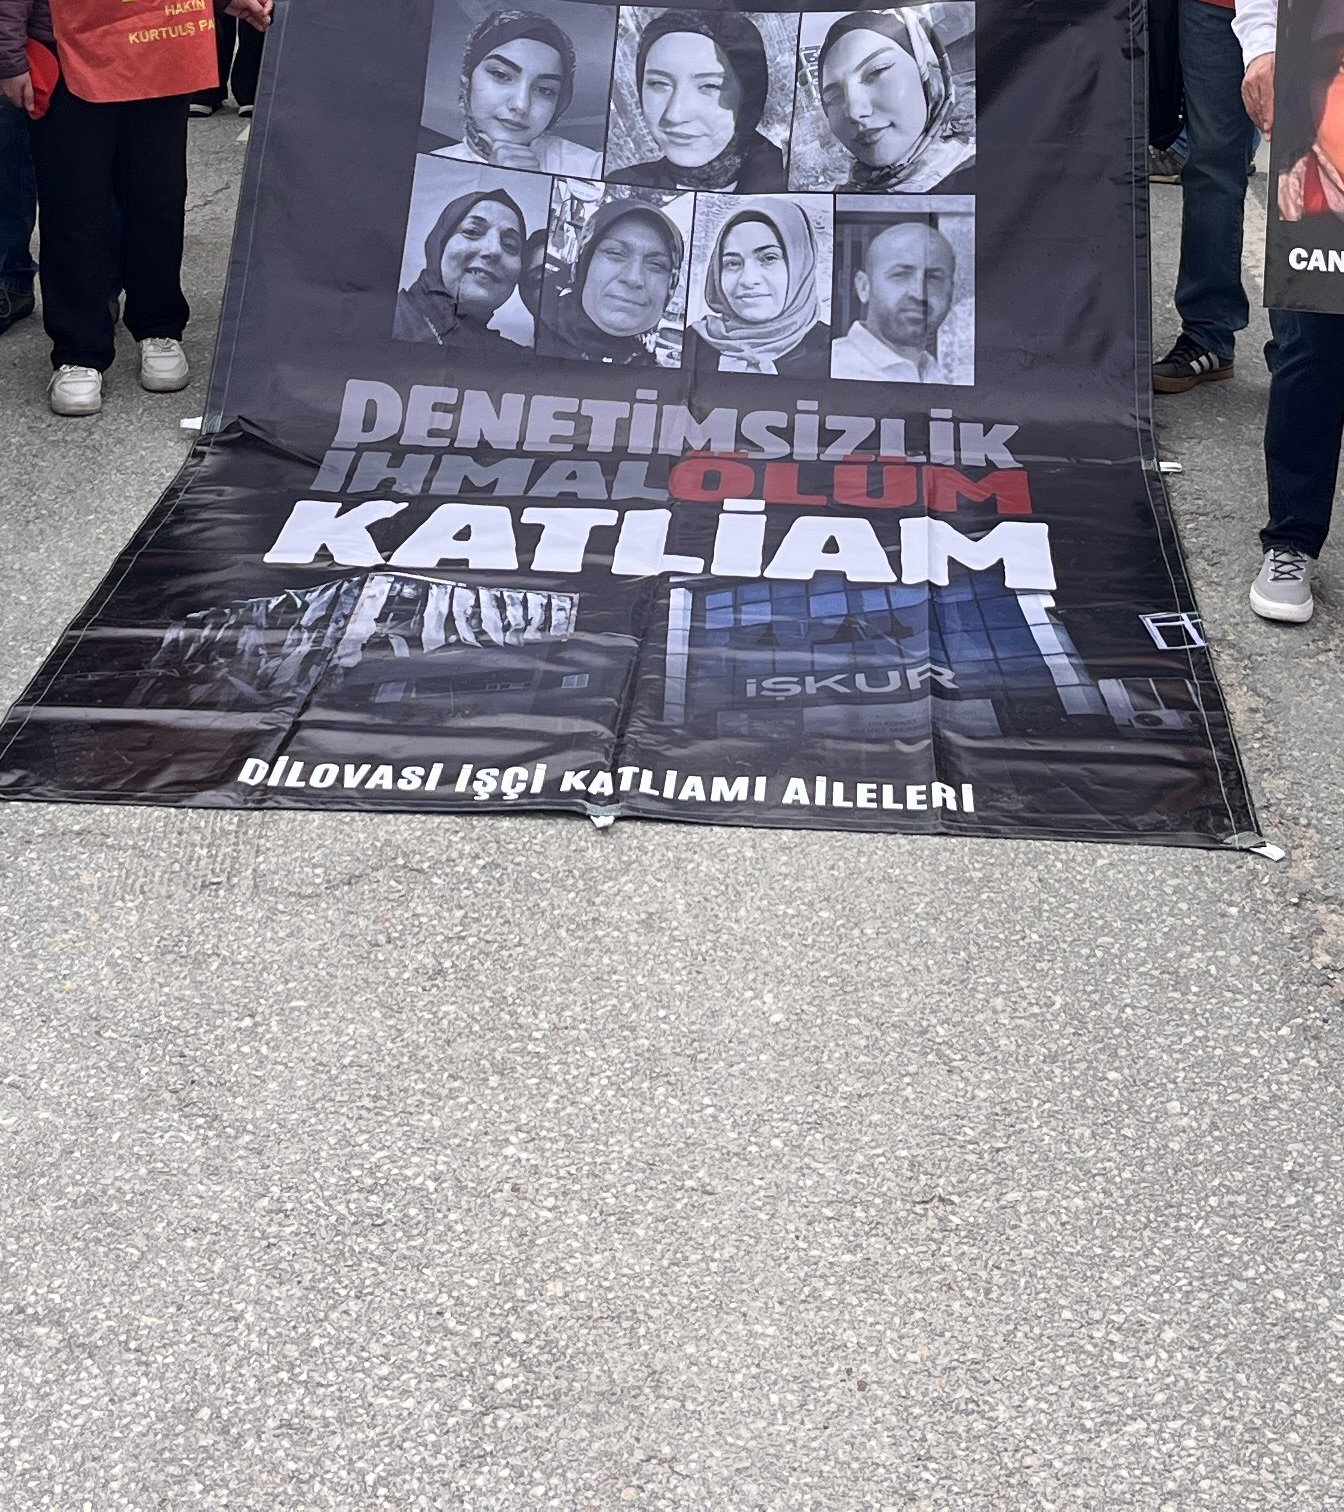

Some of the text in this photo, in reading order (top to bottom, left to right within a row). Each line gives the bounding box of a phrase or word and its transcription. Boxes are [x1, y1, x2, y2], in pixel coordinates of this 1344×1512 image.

[333, 377, 1024, 469] DENETİMSİZLİK
[668, 449, 1033, 515] ÖLÜM
[262, 498, 1058, 591] KATLİAM
